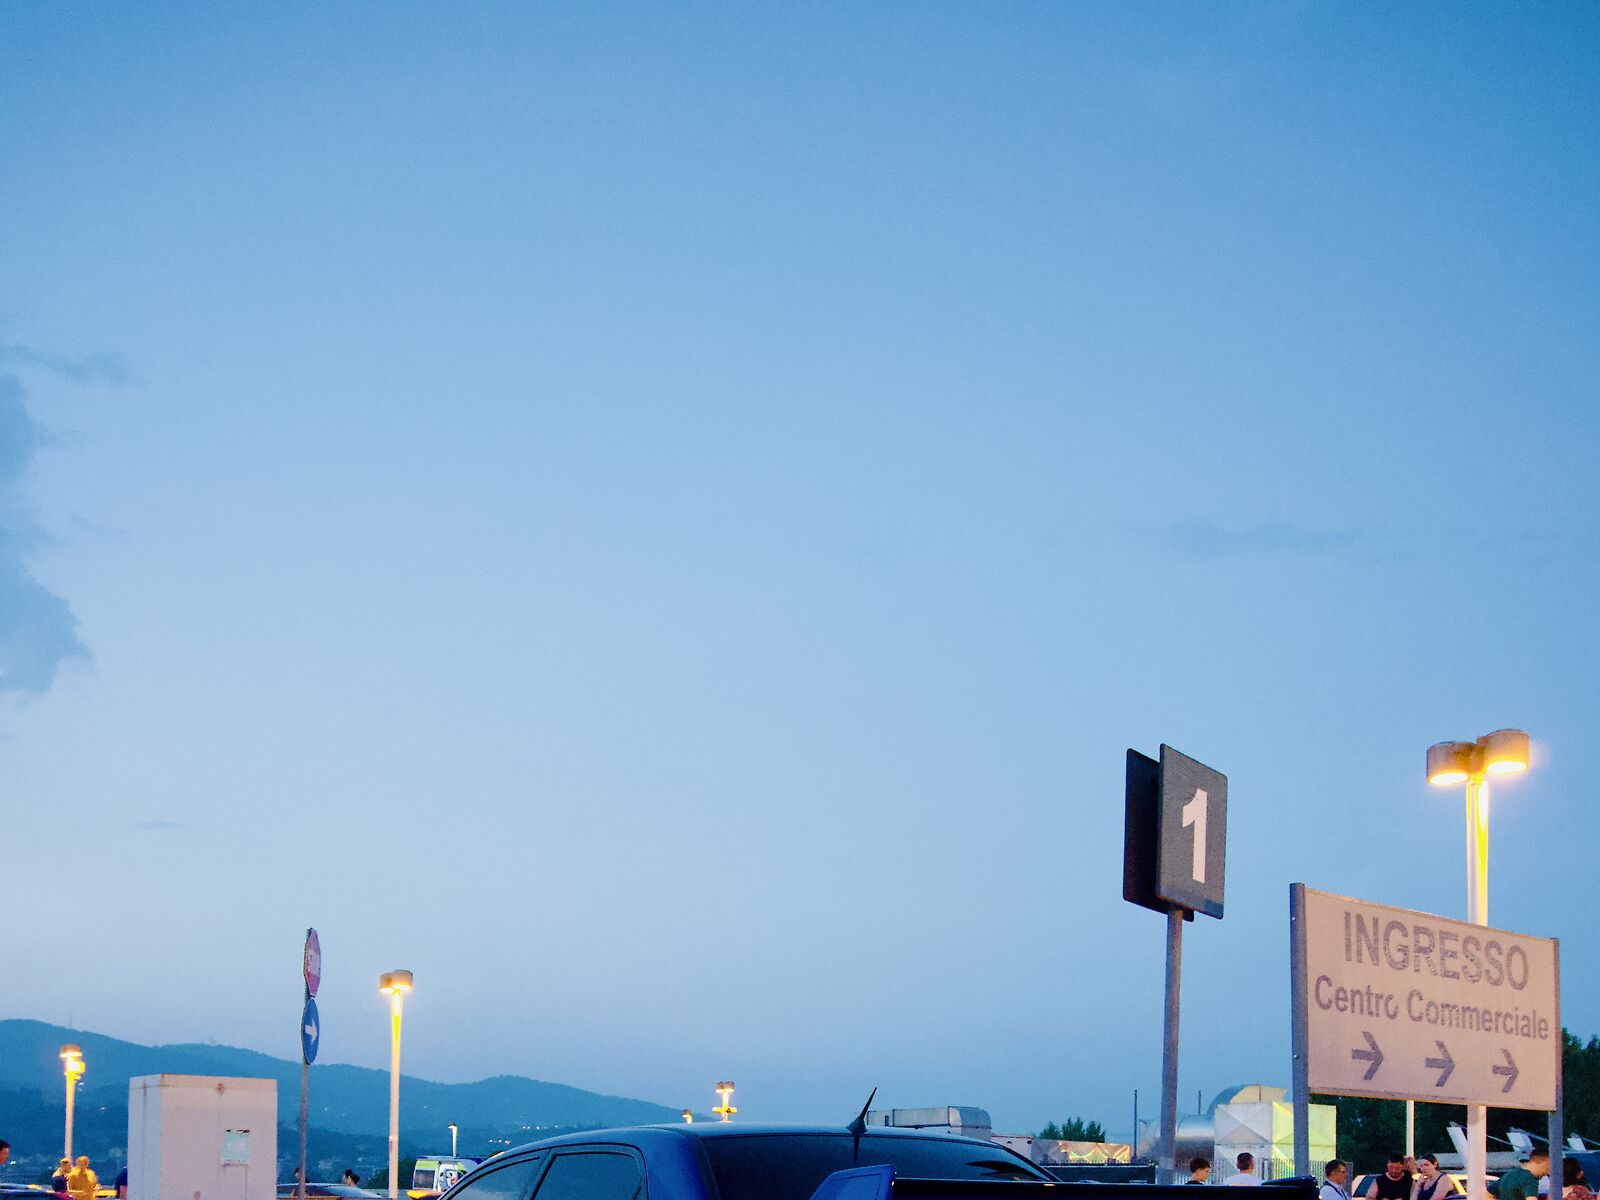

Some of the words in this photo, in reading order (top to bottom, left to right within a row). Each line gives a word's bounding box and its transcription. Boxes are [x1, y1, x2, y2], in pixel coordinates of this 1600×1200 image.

[1182, 787, 1208, 884] 1
[1344, 911, 1529, 990] INGRESSO
[1314, 974, 1399, 1020] Centro
[1407, 989, 1549, 1040] Commerciale
